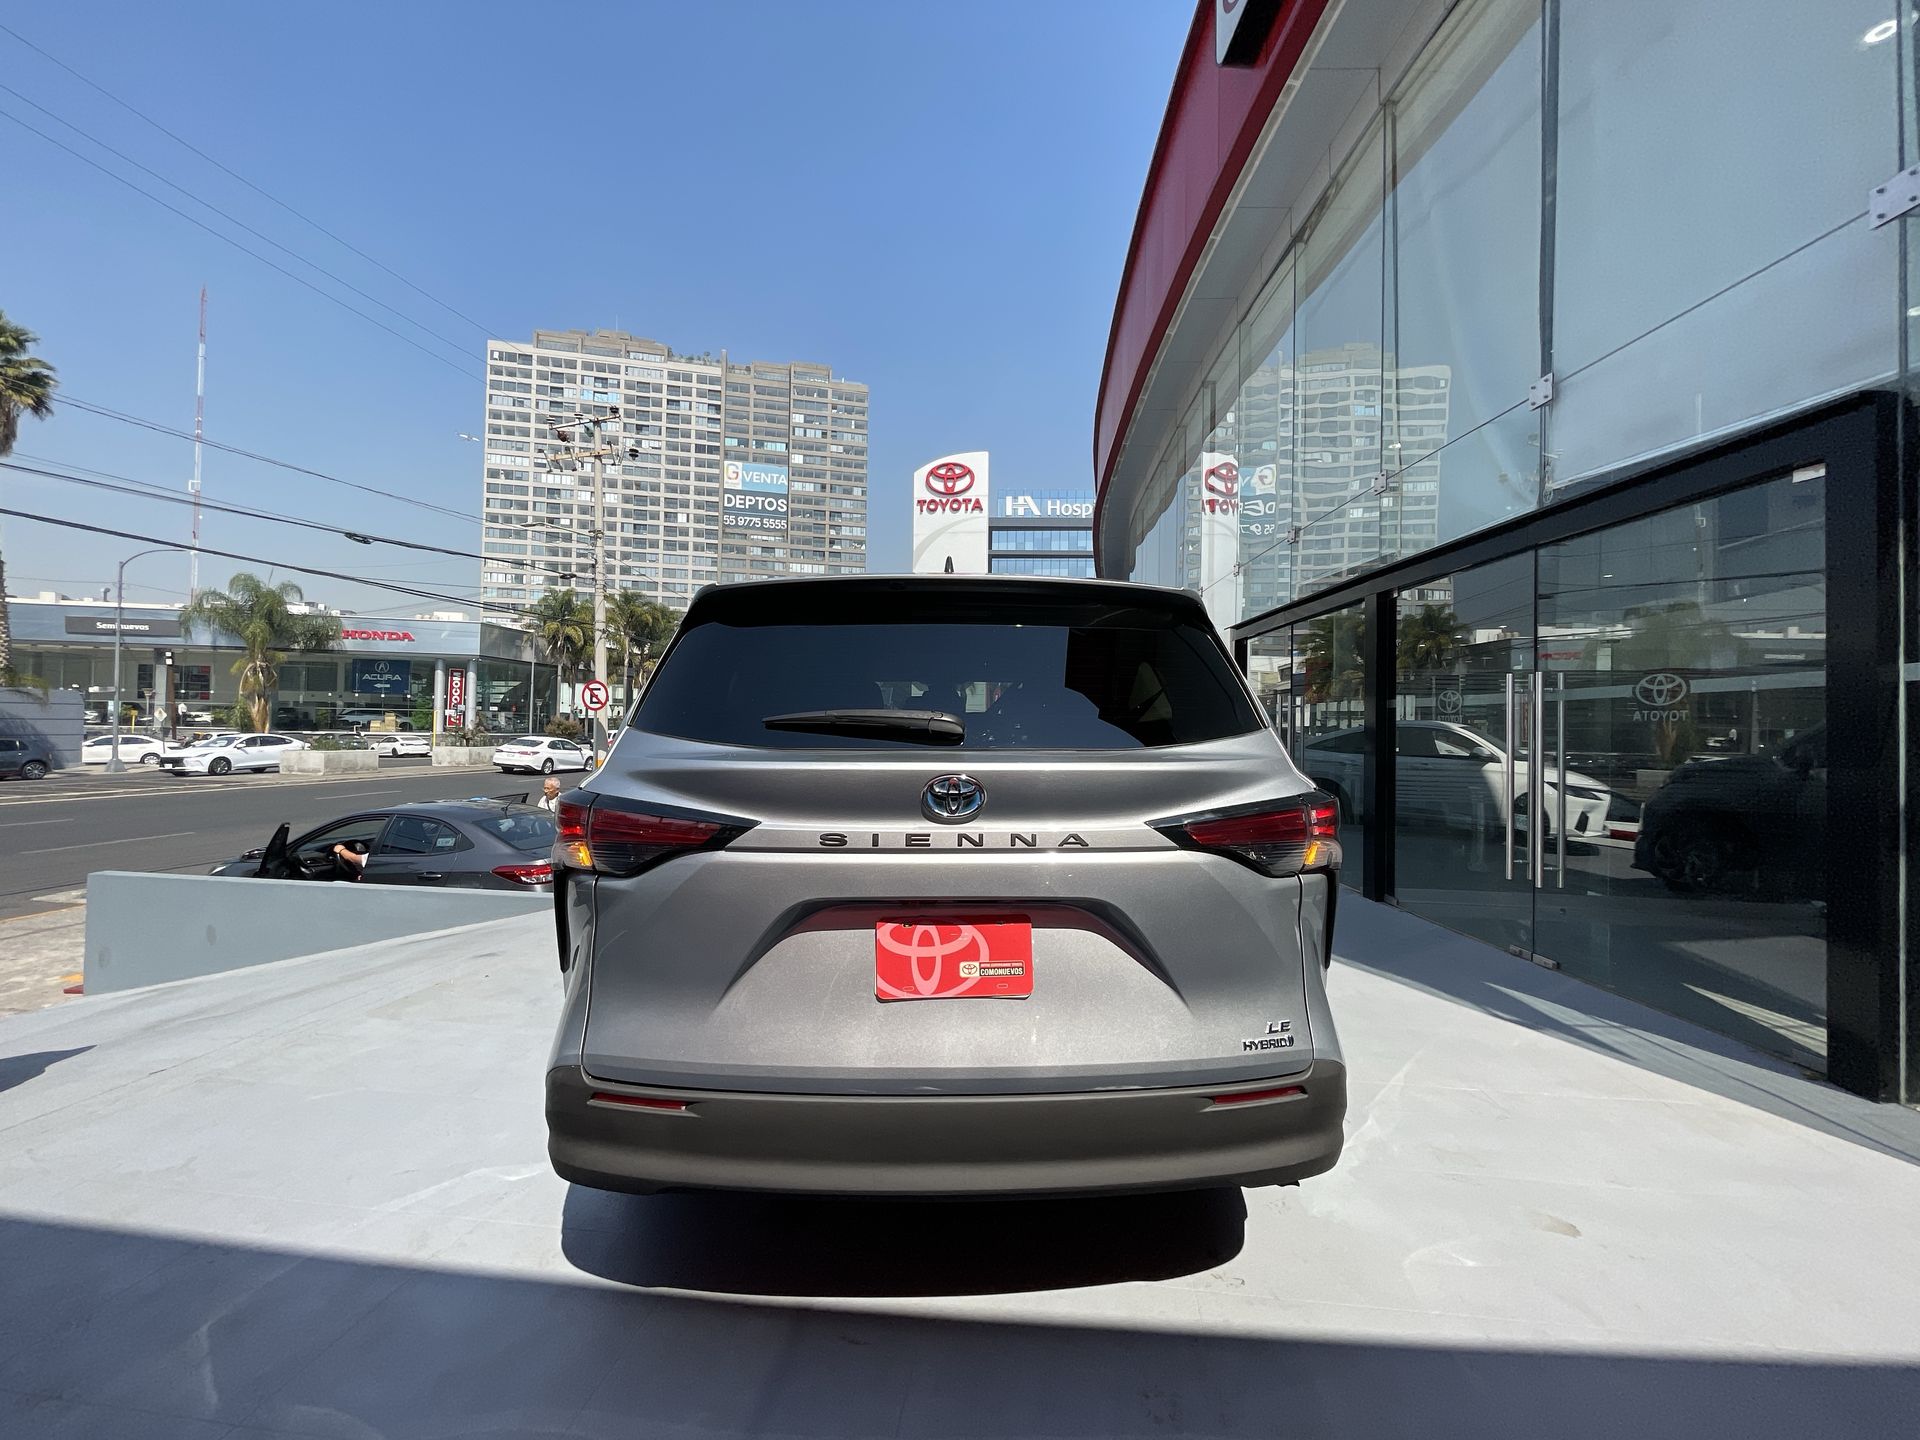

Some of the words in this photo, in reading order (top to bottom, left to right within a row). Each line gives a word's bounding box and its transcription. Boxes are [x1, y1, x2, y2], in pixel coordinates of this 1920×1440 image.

[743, 470, 788, 486] VENTA
[724, 494, 787, 512] DEPTOS
[916, 498, 983, 514] TOYOTA
[723, 515, 736, 526] 55
[738, 516, 761, 528] 9775
[763, 518, 787, 530] 5555
[341, 629, 415, 642] HONDA
[361, 673, 402, 681] ACURA
[590, 687, 601, 704] E
[818, 832, 1090, 848] SIENNA
[980, 967, 1024, 976] COMONUEVOS
[1264, 1019, 1291, 1034] LE
[1241, 1036, 1287, 1051] HYBRID
